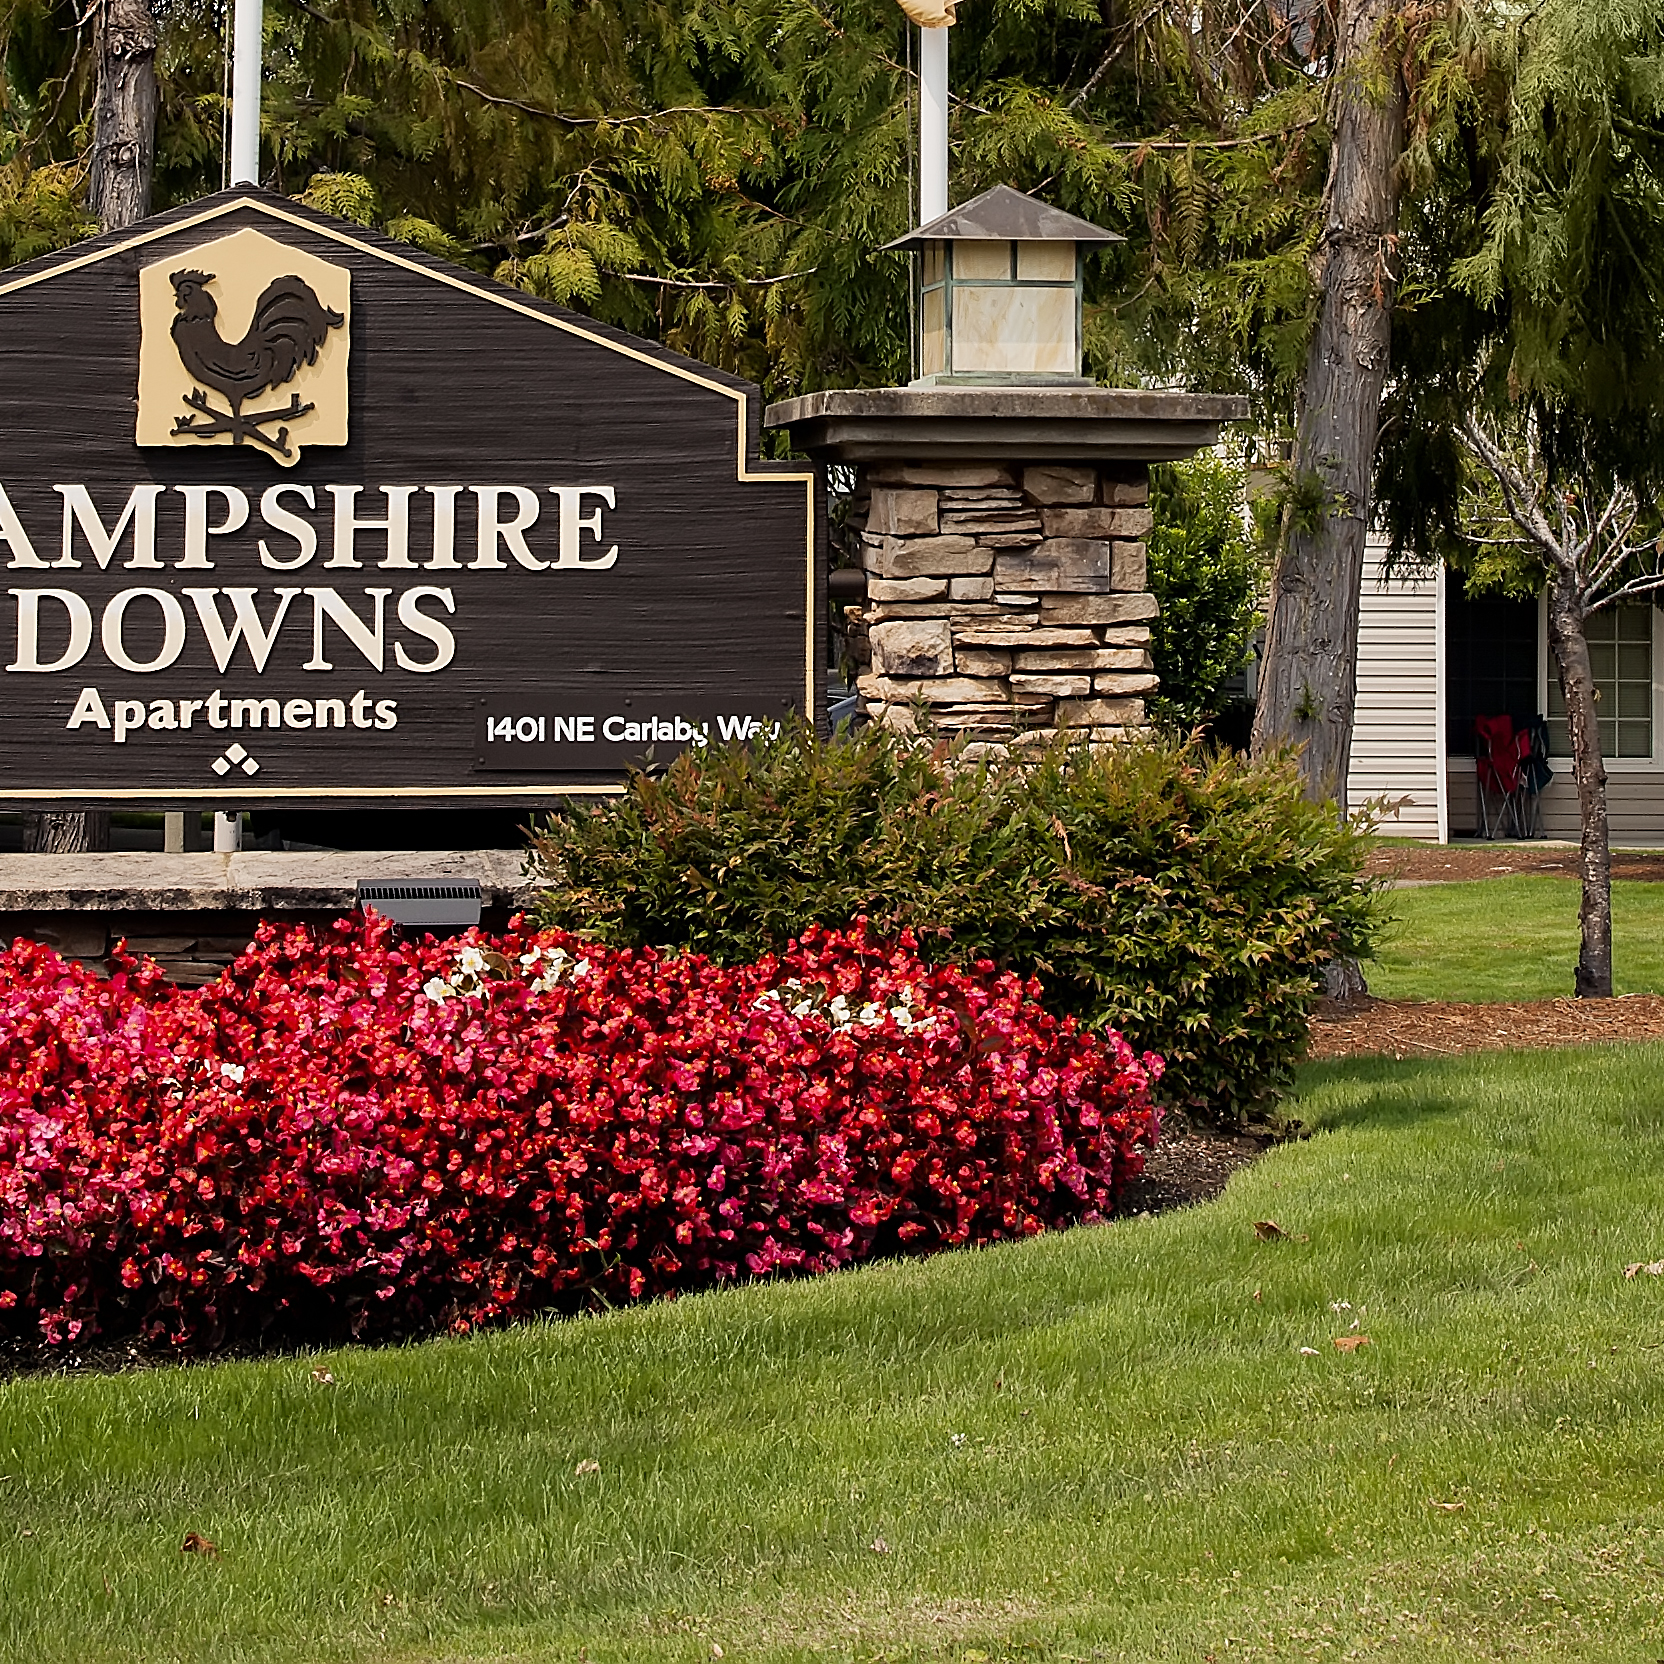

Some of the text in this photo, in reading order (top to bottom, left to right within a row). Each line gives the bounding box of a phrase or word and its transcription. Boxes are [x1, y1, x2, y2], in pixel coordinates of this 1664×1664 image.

[5, 585, 456, 674] DOWNS
[65, 687, 398, 743] Apartments
[486, 716, 546, 742] 1401
[554, 716, 595, 742] NE
[602, 715, 709, 748] Carlaby
